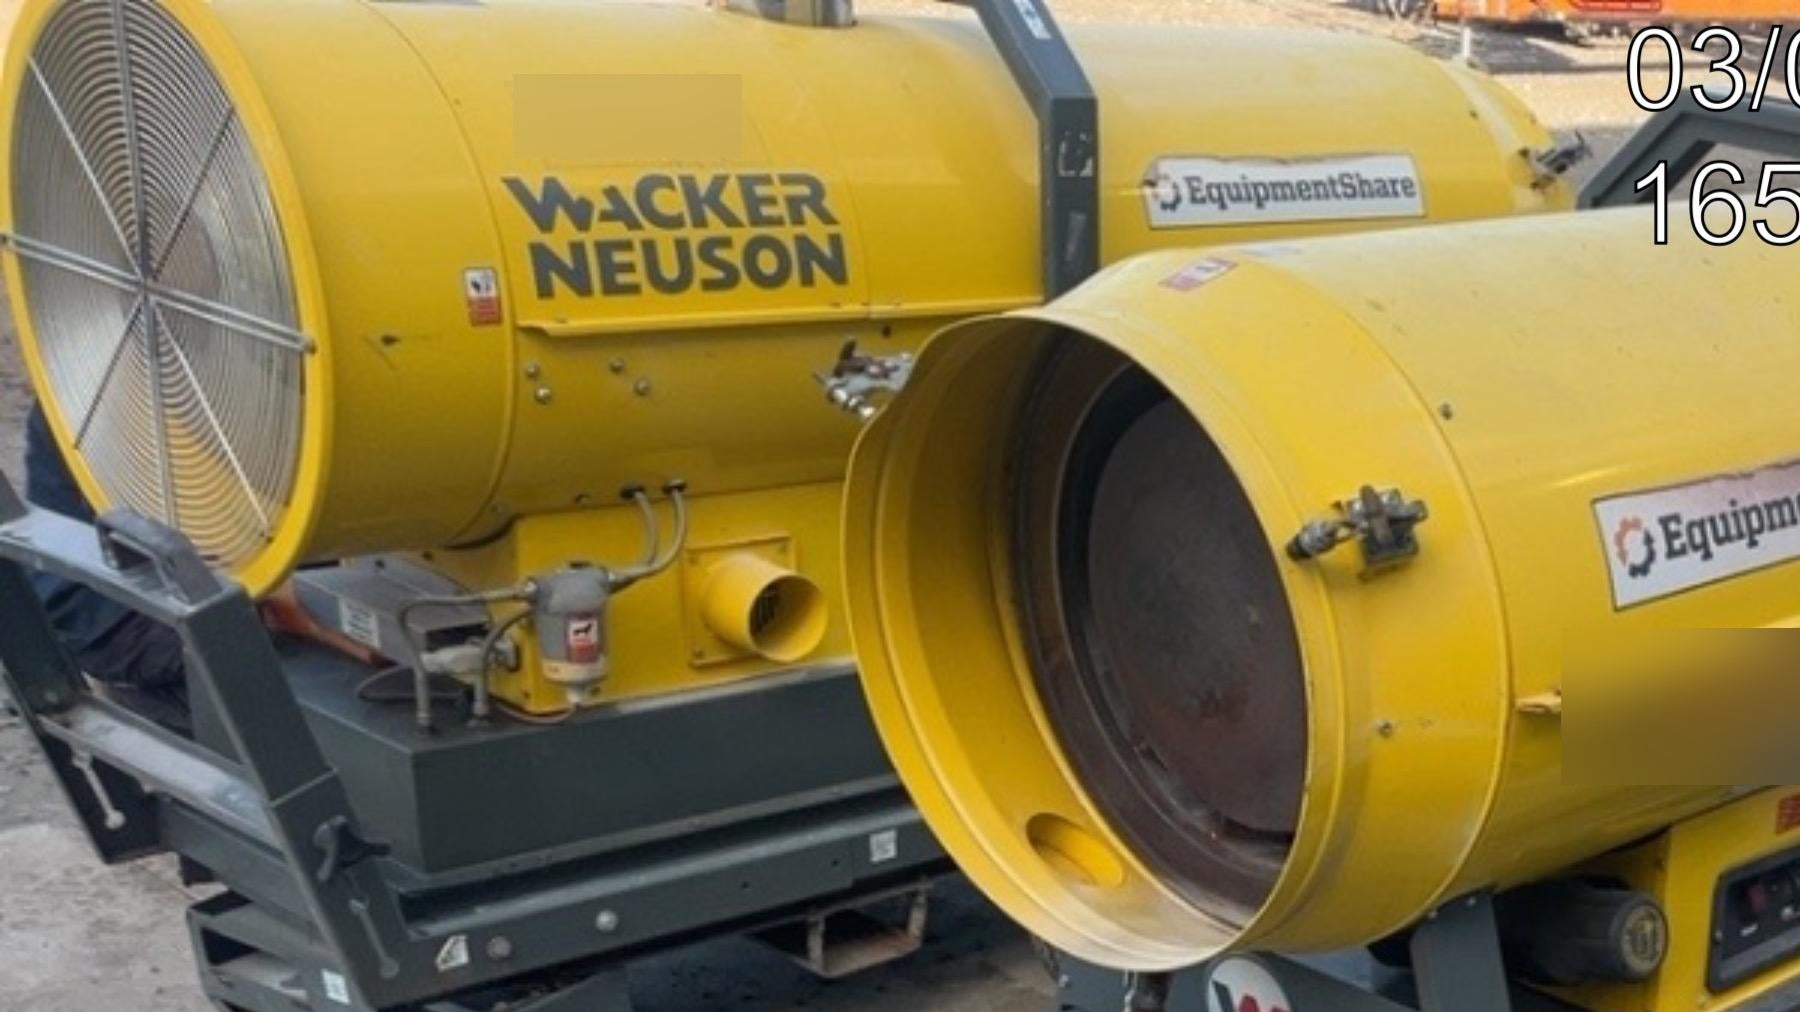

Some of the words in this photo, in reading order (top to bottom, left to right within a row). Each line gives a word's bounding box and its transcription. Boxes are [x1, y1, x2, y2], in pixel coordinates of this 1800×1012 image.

[502, 173, 837, 235] WACKER
[1184, 172, 1416, 210] EquipmentShare
[527, 233, 849, 300] NEUSON
